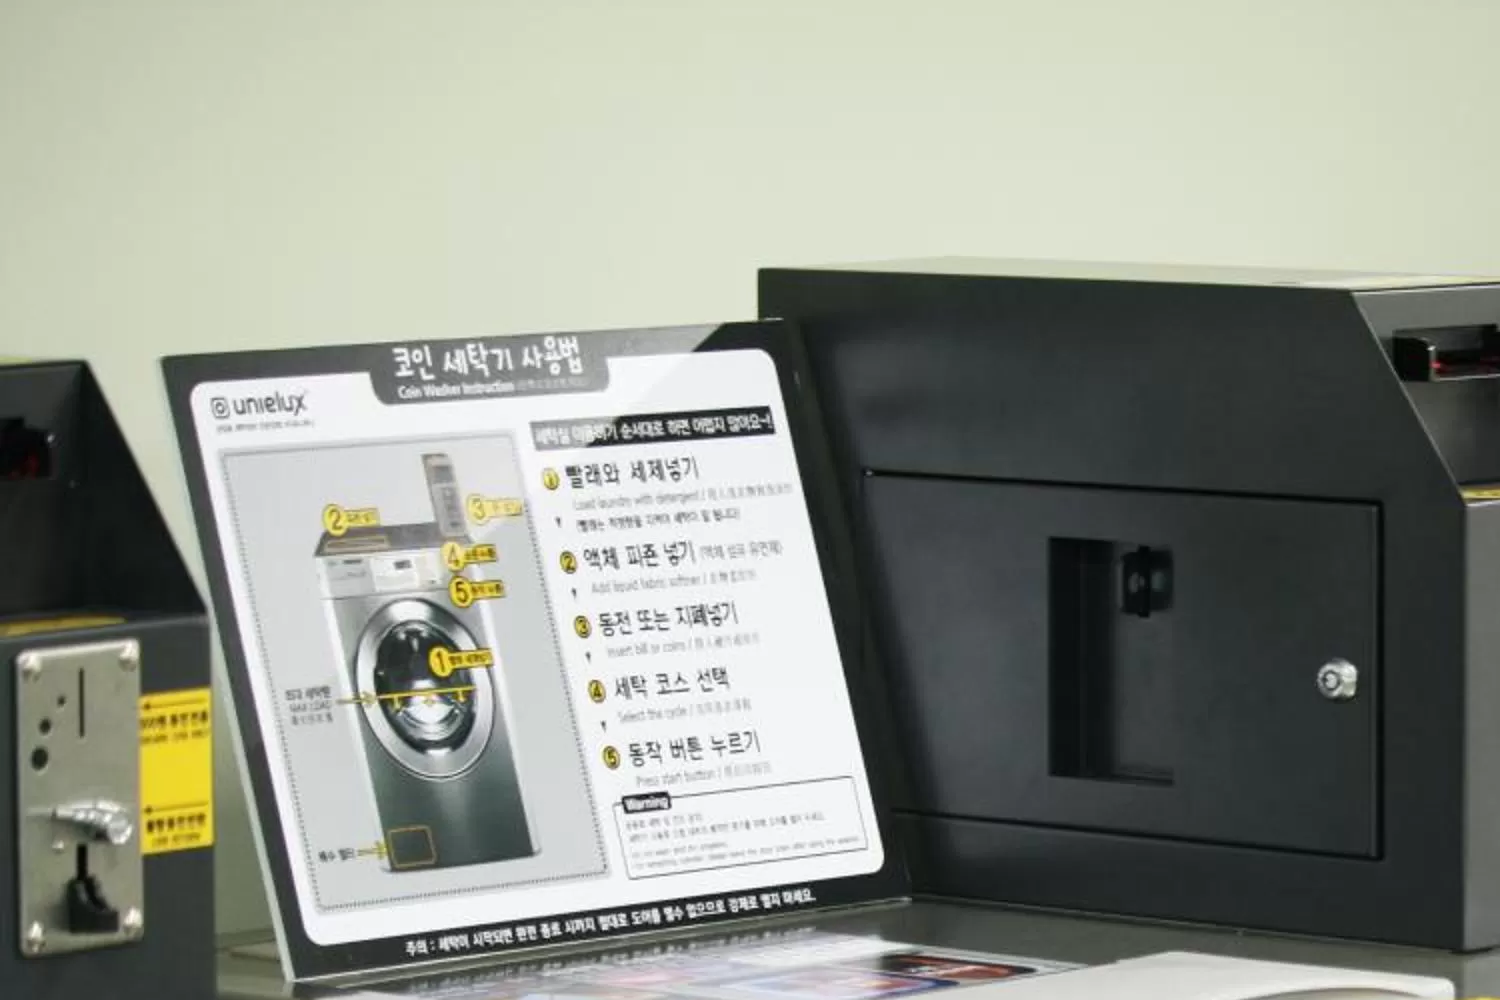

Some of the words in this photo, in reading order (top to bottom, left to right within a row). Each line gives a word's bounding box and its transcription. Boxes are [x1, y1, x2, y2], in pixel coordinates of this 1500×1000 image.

[392, 344, 436, 381] 코인
[443, 342, 514, 377] 세탁기
[522, 336, 584, 375] 사용법
[565, 464, 620, 489] 빨래와
[631, 456, 700, 483] 세제넣기
[328, 508, 343, 531] 2
[583, 546, 619, 571] 액체
[664, 540, 697, 567] 넣기
[455, 581, 468, 603] 5
[599, 611, 633, 637] 동전
[636, 608, 670, 631] 또는
[674, 601, 739, 628] 지폐넣기
[615, 675, 648, 701] 세탁
[656, 672, 691, 695] 코스
[697, 667, 731, 693] 선택
[629, 741, 663, 768] 동작
[670, 737, 704, 761] 버튼
[711, 729, 761, 757] 누르기
